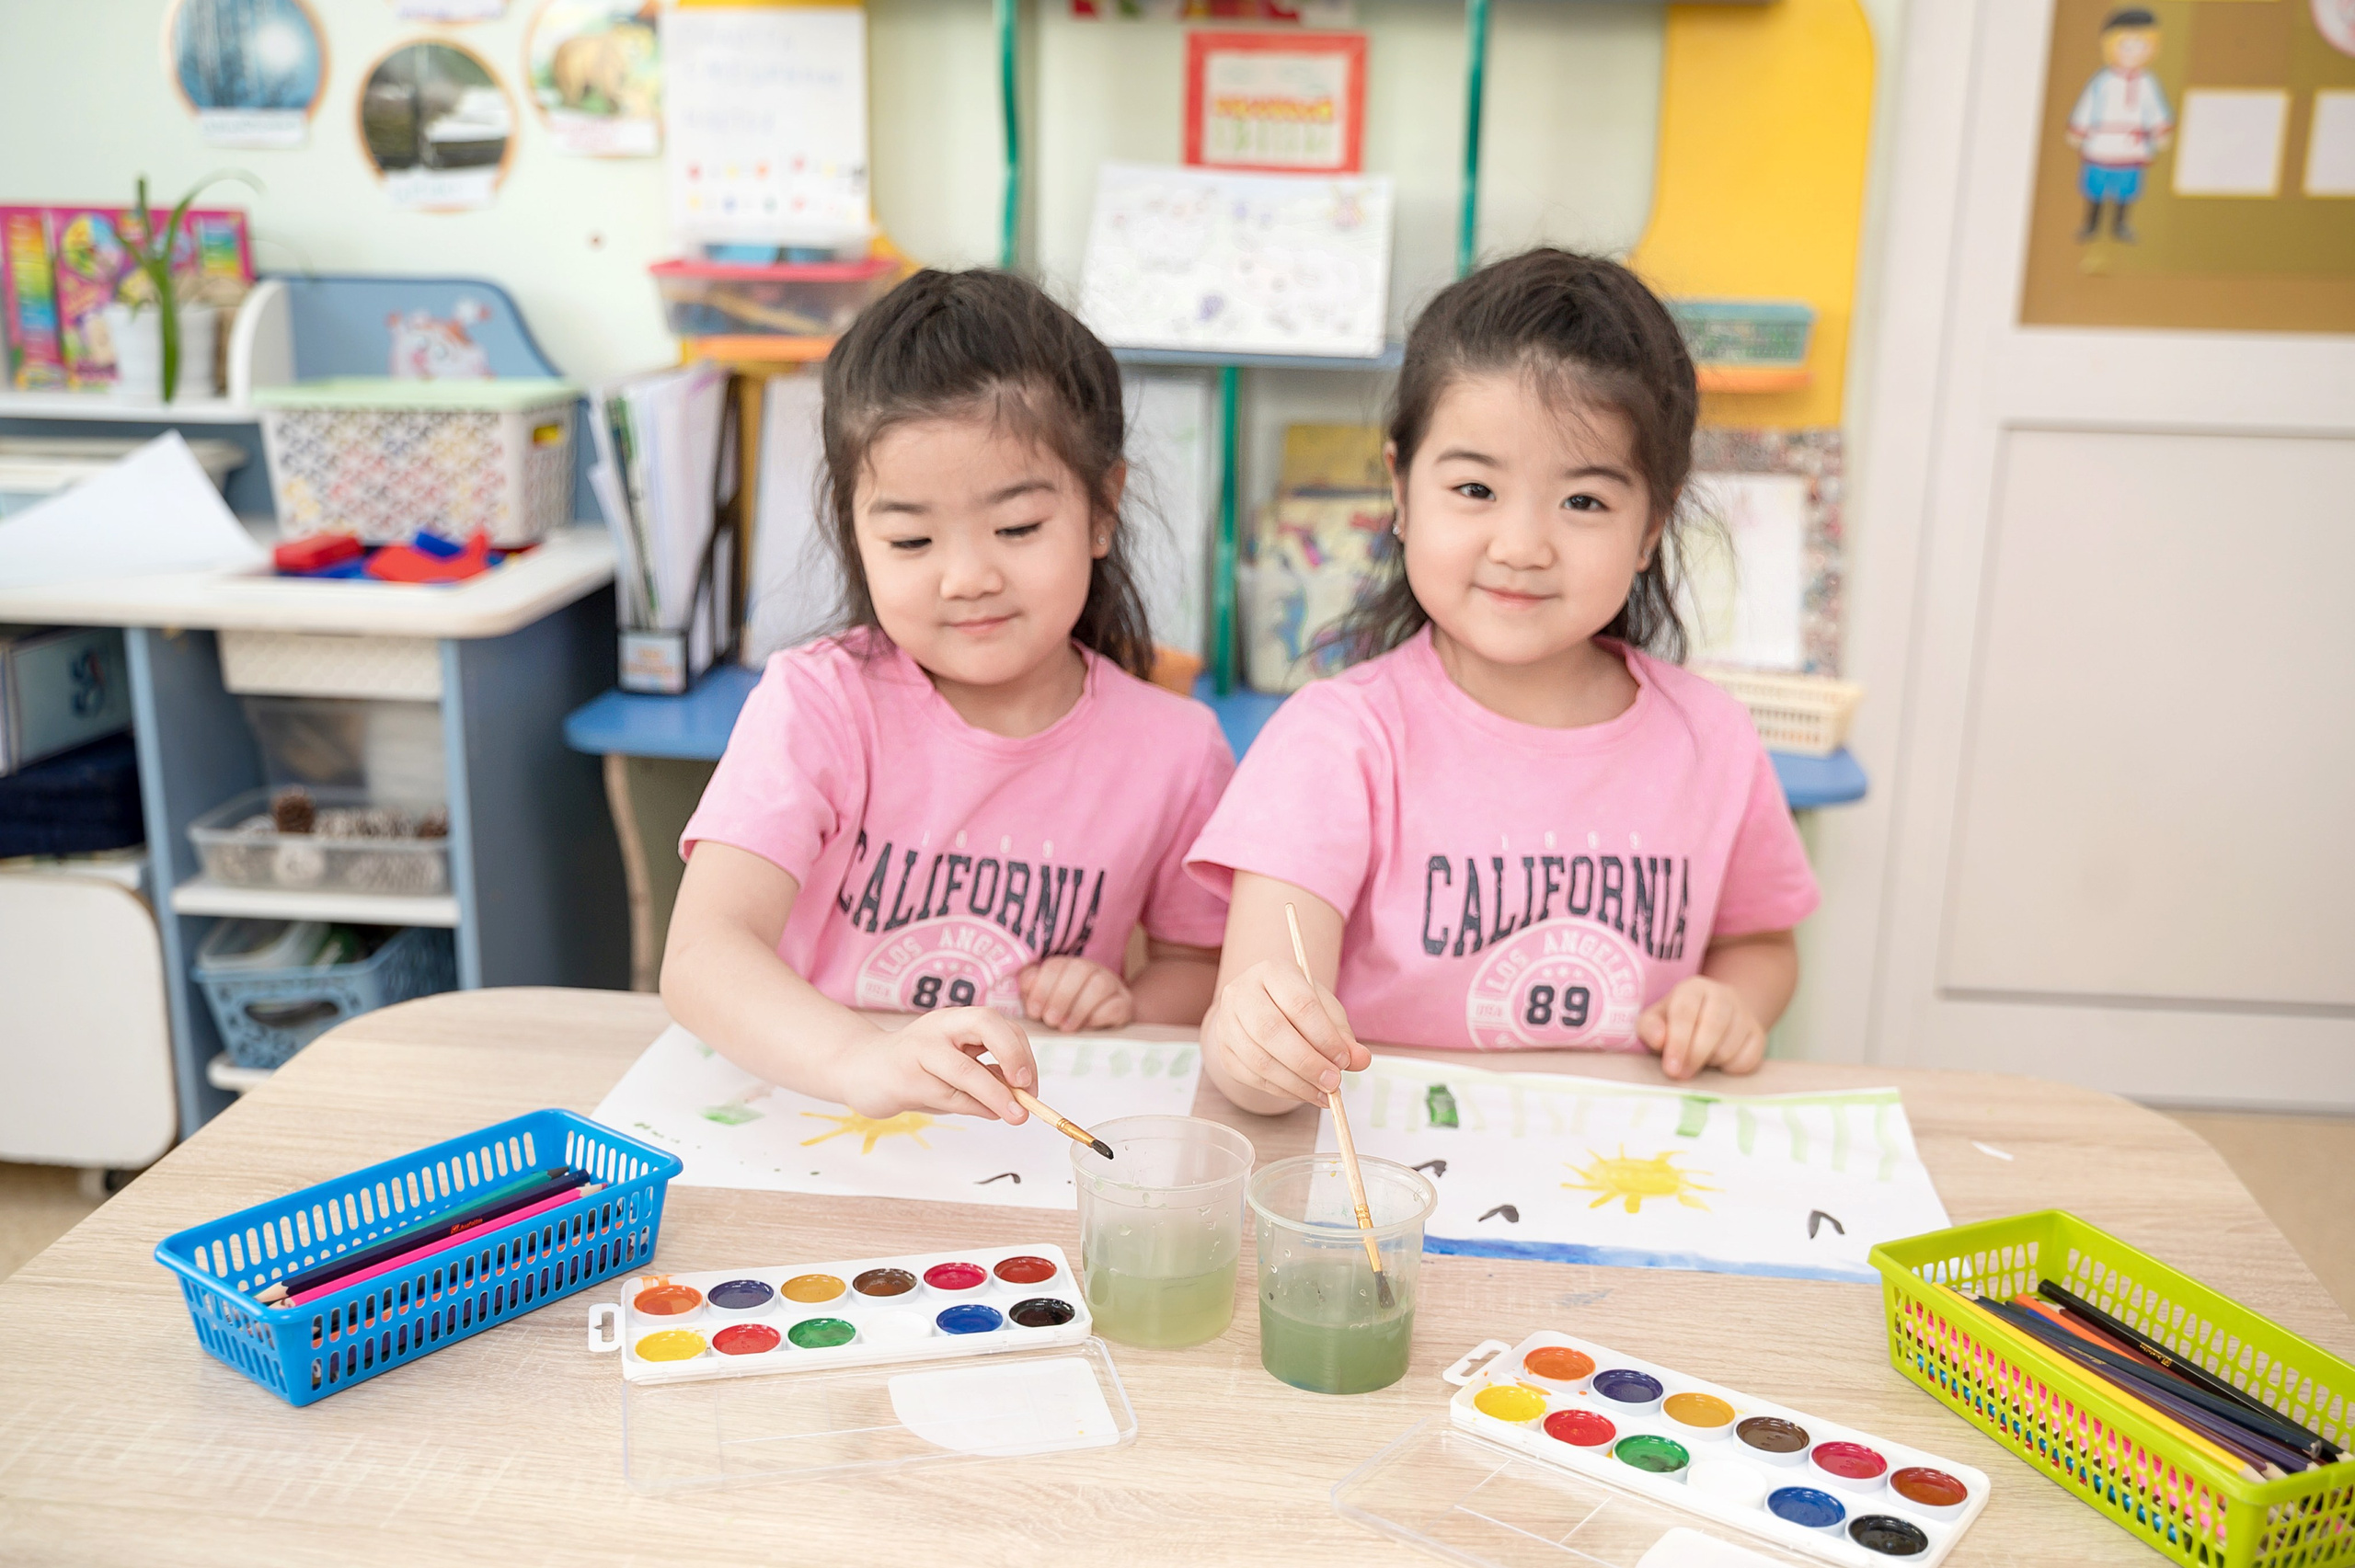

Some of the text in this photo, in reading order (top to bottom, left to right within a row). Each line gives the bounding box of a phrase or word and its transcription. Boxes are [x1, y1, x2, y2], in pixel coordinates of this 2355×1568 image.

[838, 829, 1105, 956] CALIFORNIA
[1422, 855, 1689, 960] CALIFORNIA
[877, 936, 923, 975] LOS
[1485, 929, 1637, 999] LOS ANGELES
[913, 975, 976, 1008] 89
[1526, 985, 1591, 1027] 89
